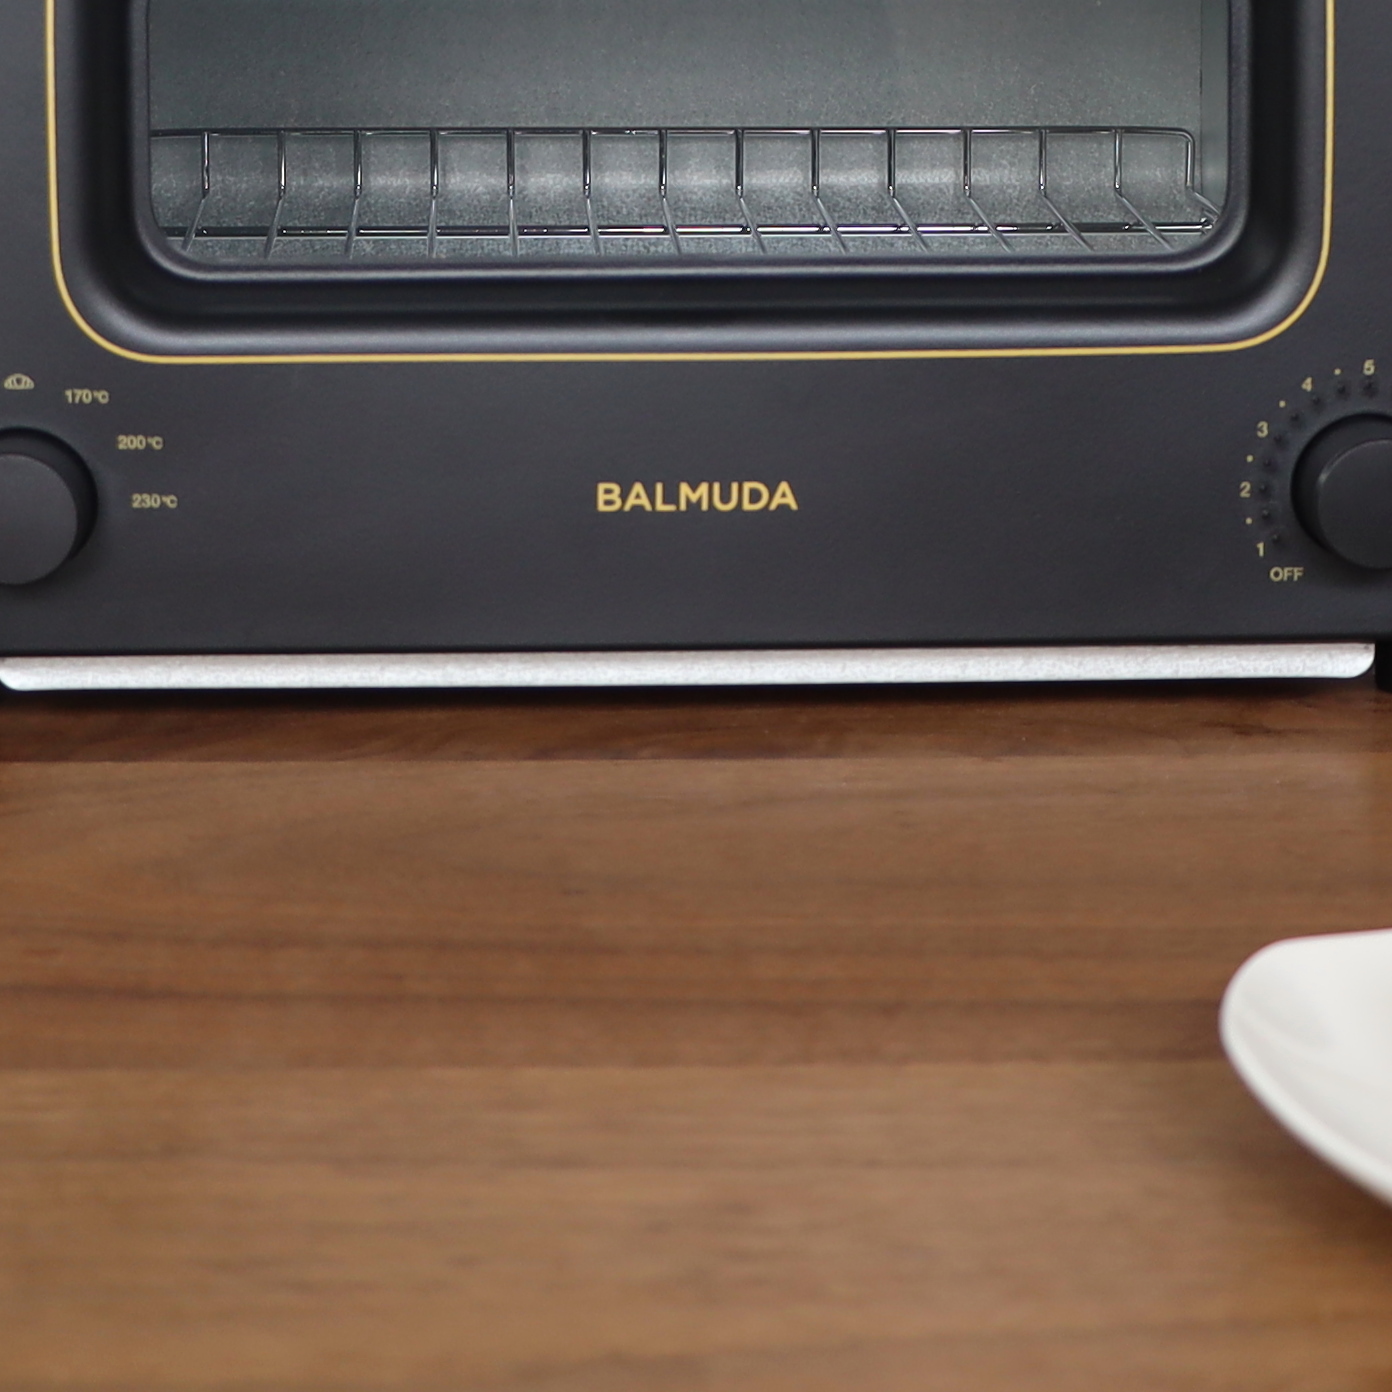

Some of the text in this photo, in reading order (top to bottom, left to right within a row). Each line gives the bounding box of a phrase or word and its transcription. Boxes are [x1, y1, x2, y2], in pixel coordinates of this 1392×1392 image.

[1363, 360, 1375, 375] 5
[1301, 377, 1313, 392] 4
[1257, 421, 1268, 437] 3
[597, 481, 799, 512] BALMUDA
[1240, 482, 1251, 497] 2
[1256, 542, 1264, 557] 1
[1269, 567, 1304, 582] OFF
